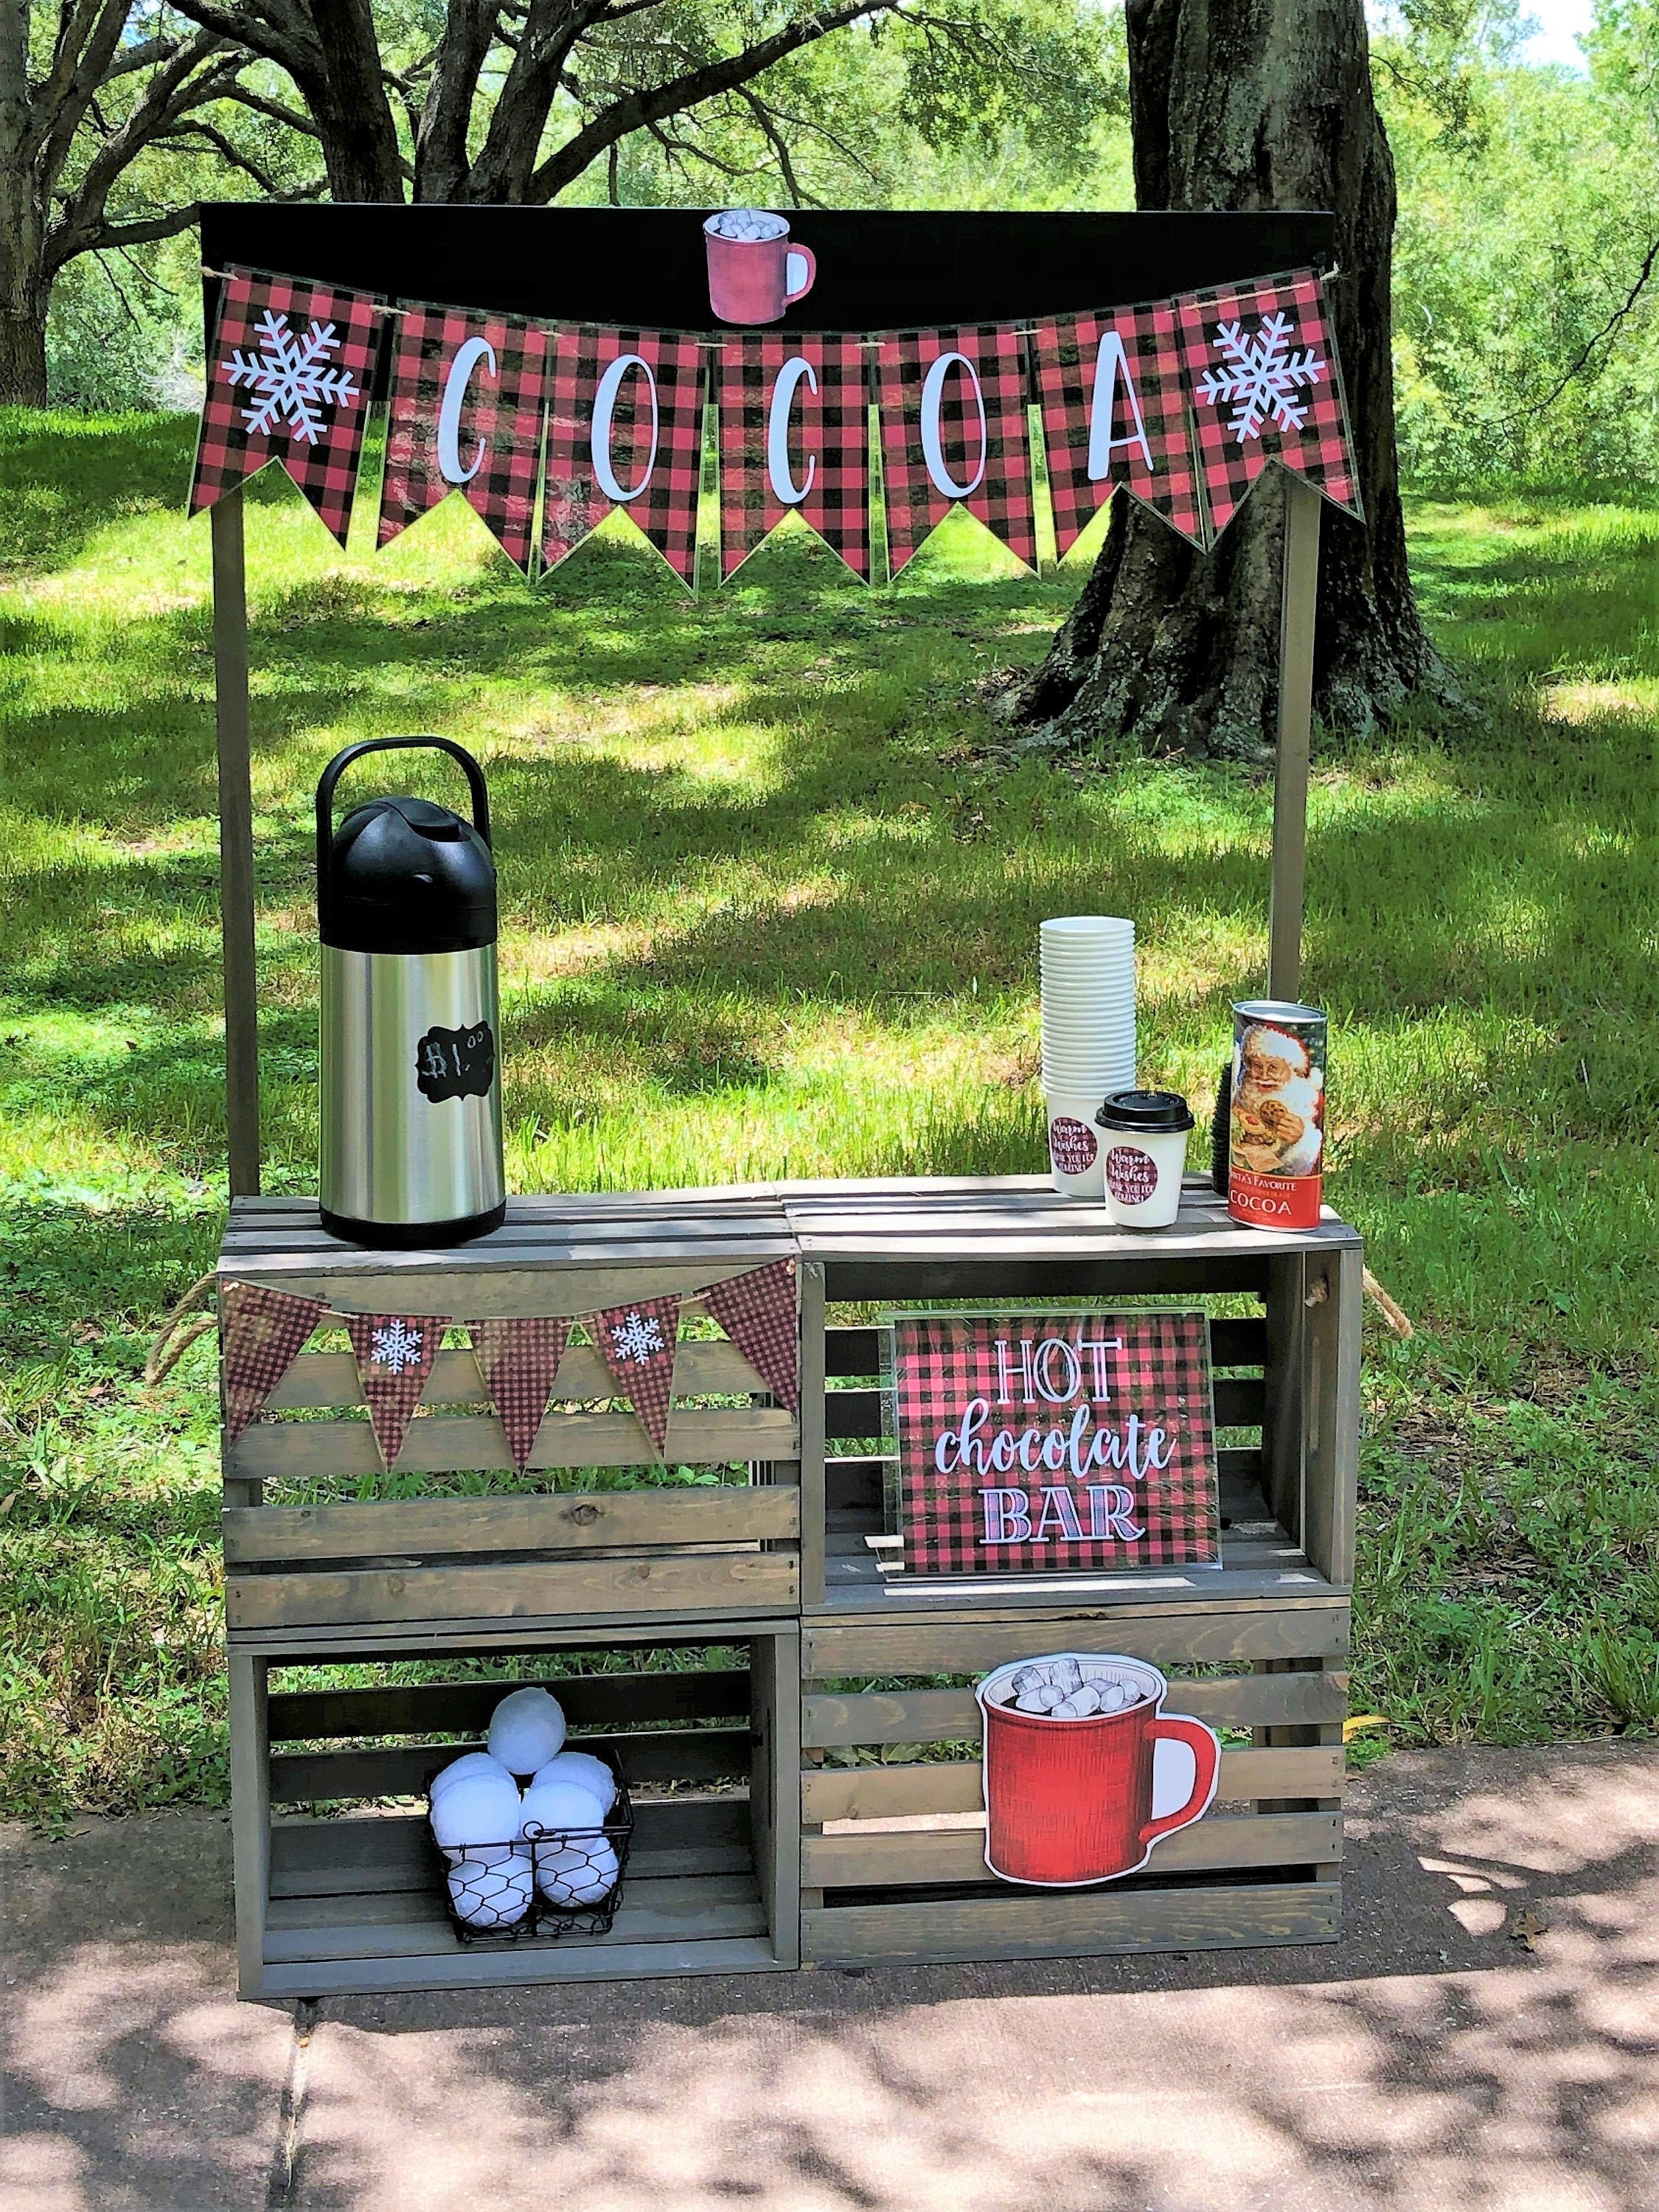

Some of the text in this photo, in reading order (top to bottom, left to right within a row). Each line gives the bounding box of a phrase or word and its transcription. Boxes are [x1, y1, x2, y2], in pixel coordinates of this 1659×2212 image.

[437, 330, 1154, 504] COCOA
[1054, 1119, 1088, 1136] Warm
[1054, 1135, 1089, 1152] Wishes
[1111, 1148, 1150, 1166] Warm
[1109, 1162, 1150, 1183] Wishes
[1230, 1169, 1297, 1191] NTA'S FAVORITE
[1230, 1189, 1293, 1215] COCOA
[995, 1338, 1122, 1405] HOT
[935, 1397, 1177, 1480] chocolate
[978, 1484, 1146, 1545] BAR
